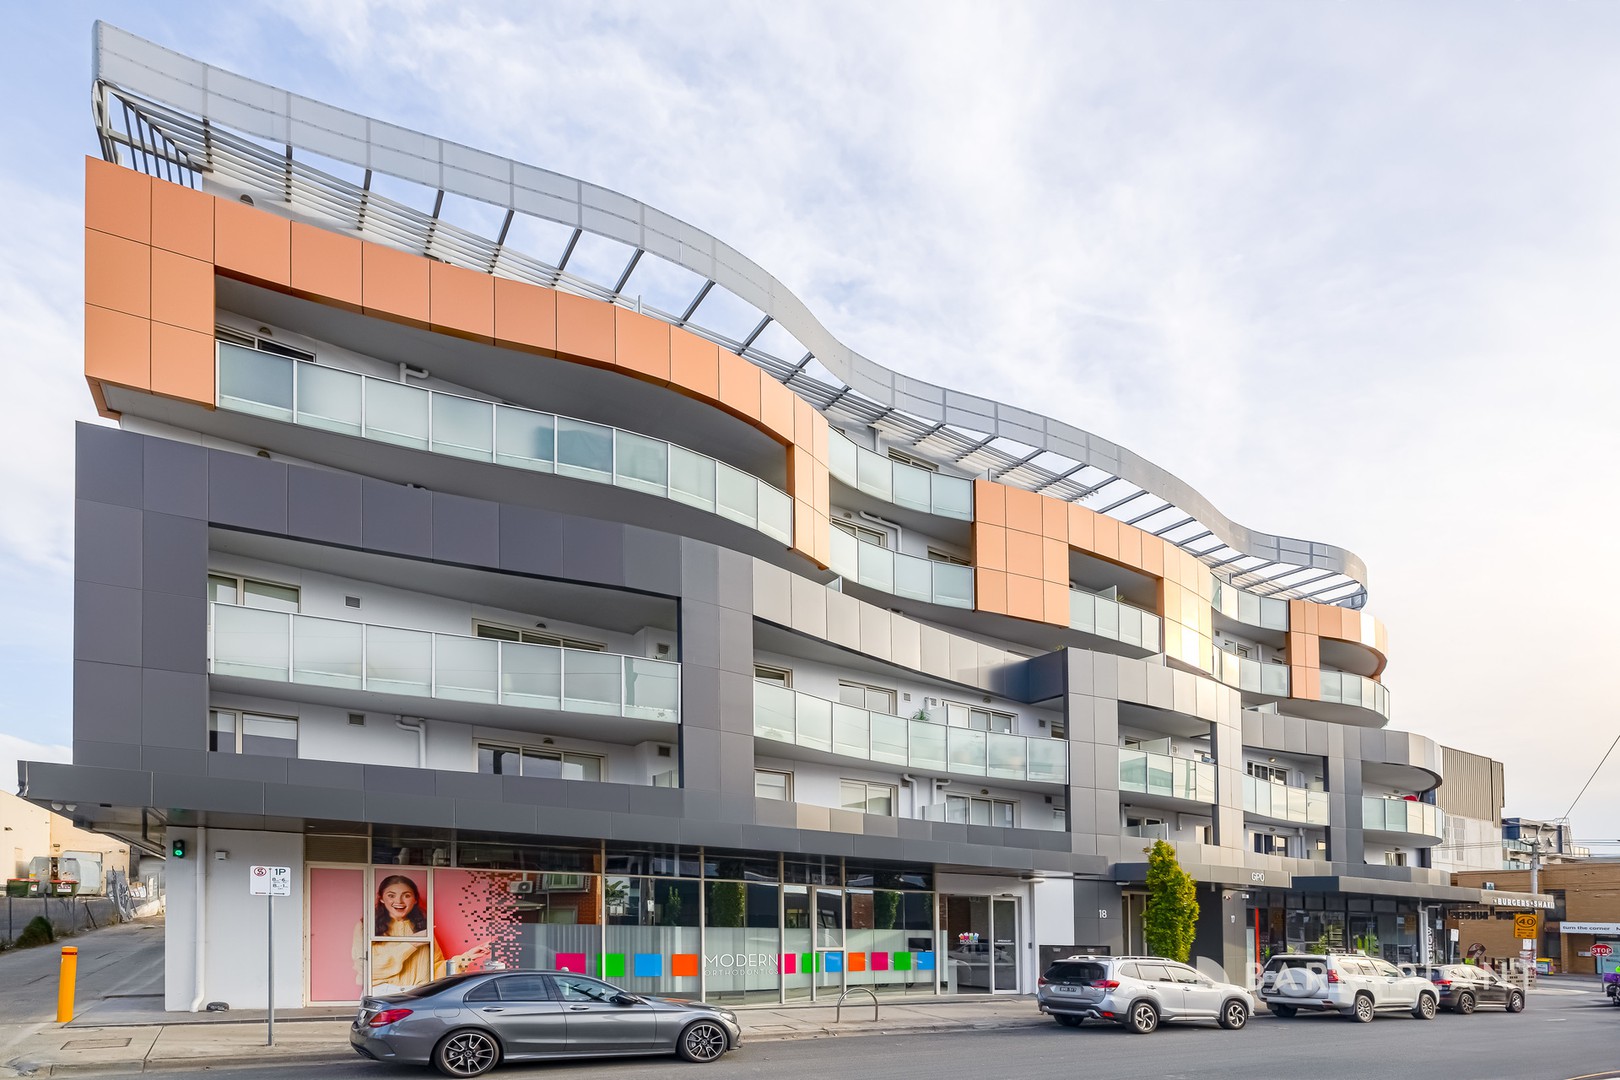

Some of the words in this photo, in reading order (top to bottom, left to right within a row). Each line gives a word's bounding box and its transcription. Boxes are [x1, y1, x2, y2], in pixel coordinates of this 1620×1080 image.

[275, 868, 286, 876] 1P
[1251, 872, 1265, 882] GPO
[1099, 909, 1108, 919] 18
[1518, 918, 1534, 926] 40
[1592, 947, 1612, 955] STOP
[703, 953, 779, 968] MODERN
